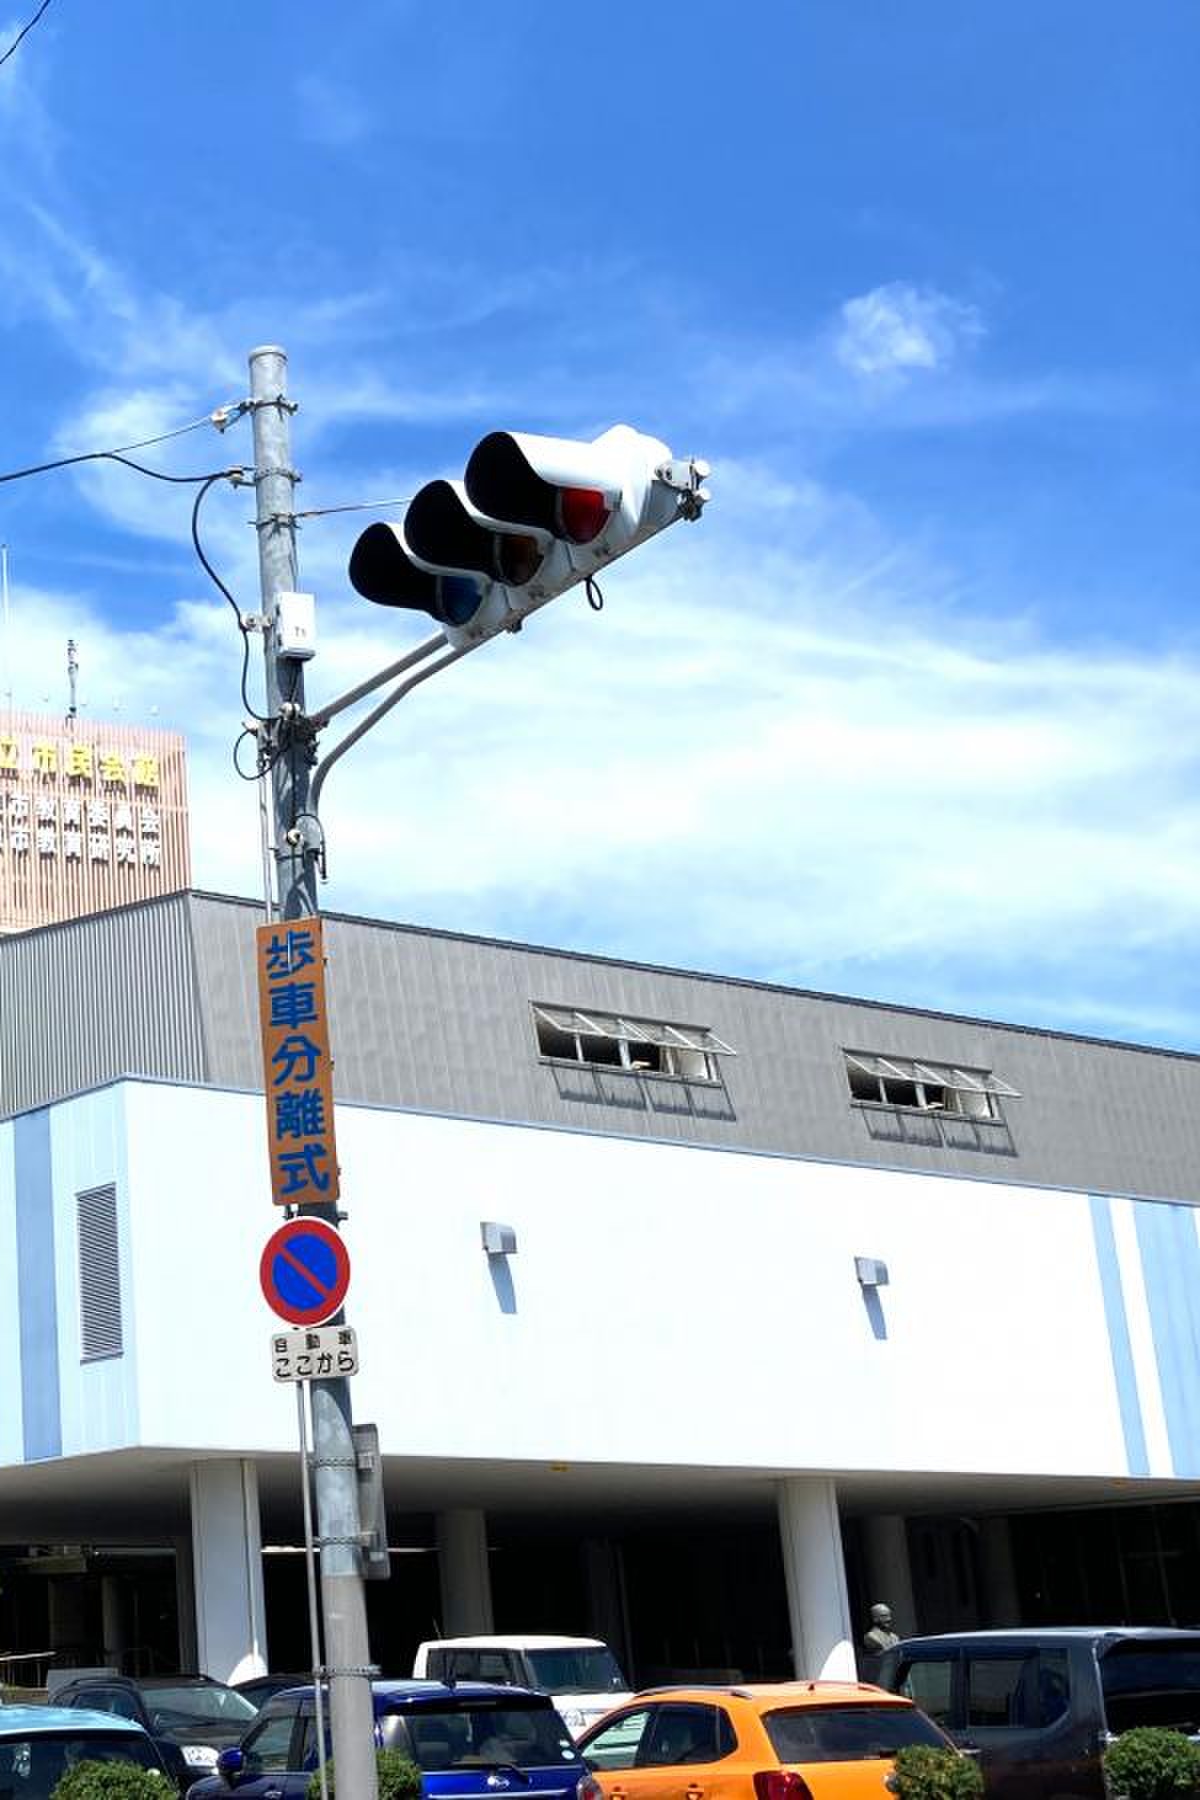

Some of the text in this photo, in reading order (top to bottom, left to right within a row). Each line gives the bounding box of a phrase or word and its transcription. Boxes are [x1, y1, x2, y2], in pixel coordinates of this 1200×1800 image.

[265, 929, 330, 1195] 歩車分離式
[275, 1330, 353, 1353] 自動車
[276, 1351, 354, 1377] ここから
